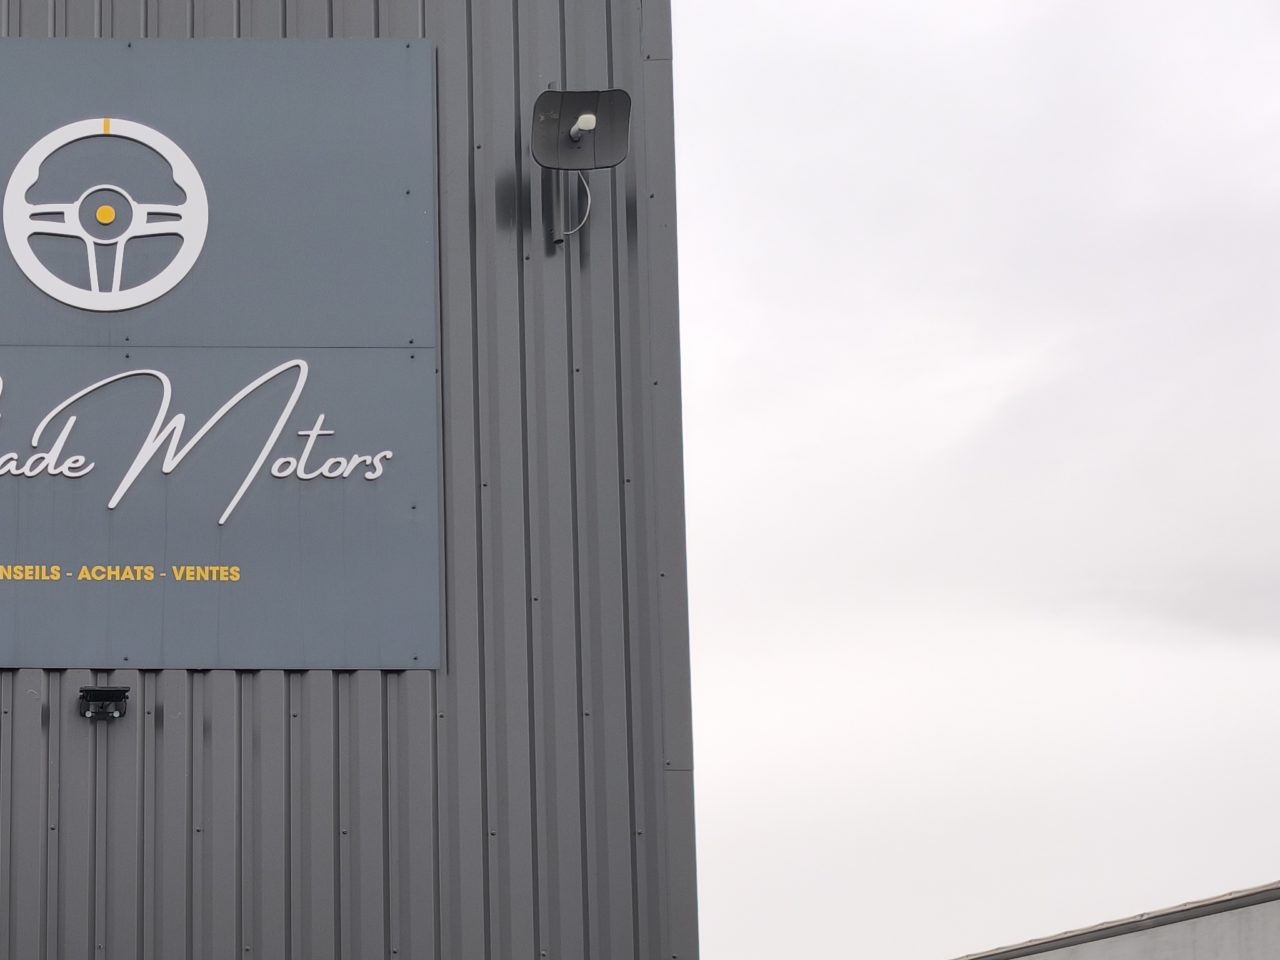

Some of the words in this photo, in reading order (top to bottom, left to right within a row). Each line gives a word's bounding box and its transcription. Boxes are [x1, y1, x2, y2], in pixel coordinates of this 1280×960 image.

[31, 359, 393, 525] Motors
[78, 565, 155, 582] ACHATS
[172, 565, 241, 582] VENTES
